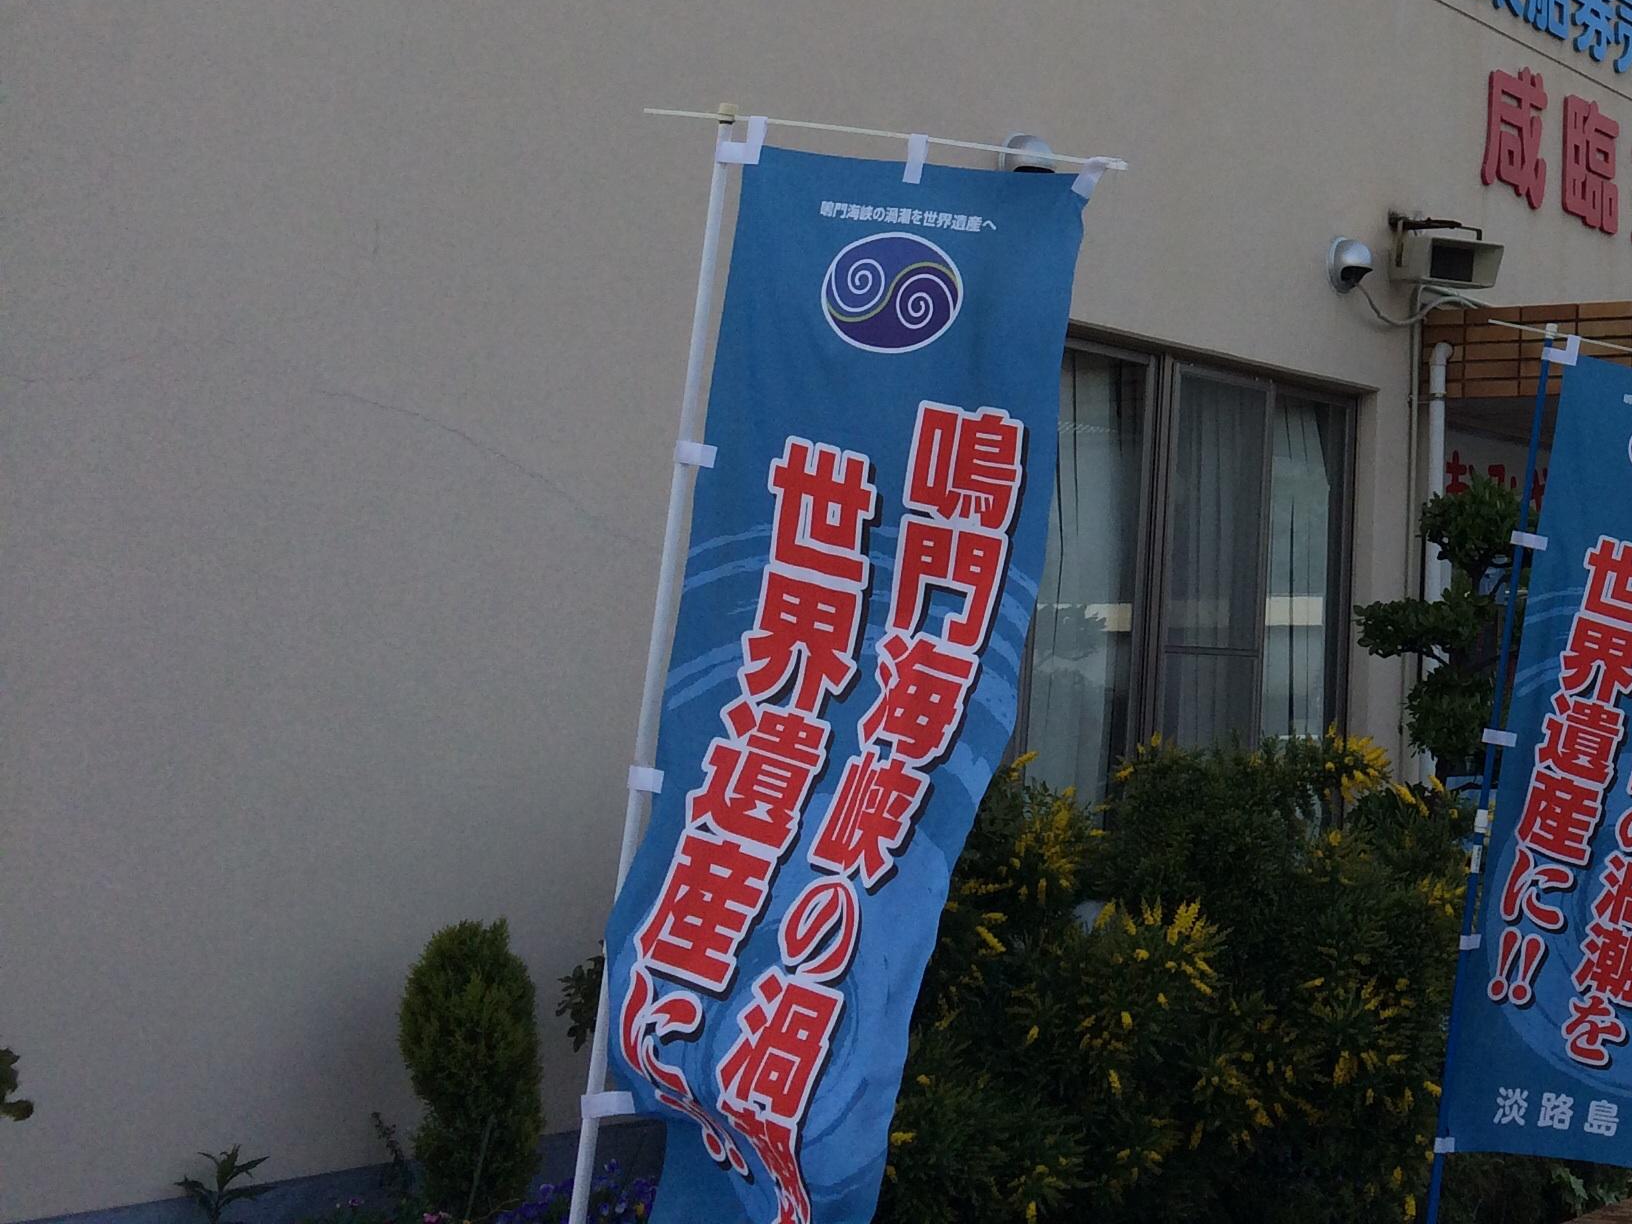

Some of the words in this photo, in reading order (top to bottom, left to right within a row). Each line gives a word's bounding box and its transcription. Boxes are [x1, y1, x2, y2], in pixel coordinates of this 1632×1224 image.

[820, 201, 997, 232] 鳴門海峡の渦潮を世界遺産へ
[1493, 1087, 1620, 1137] 淡路島
